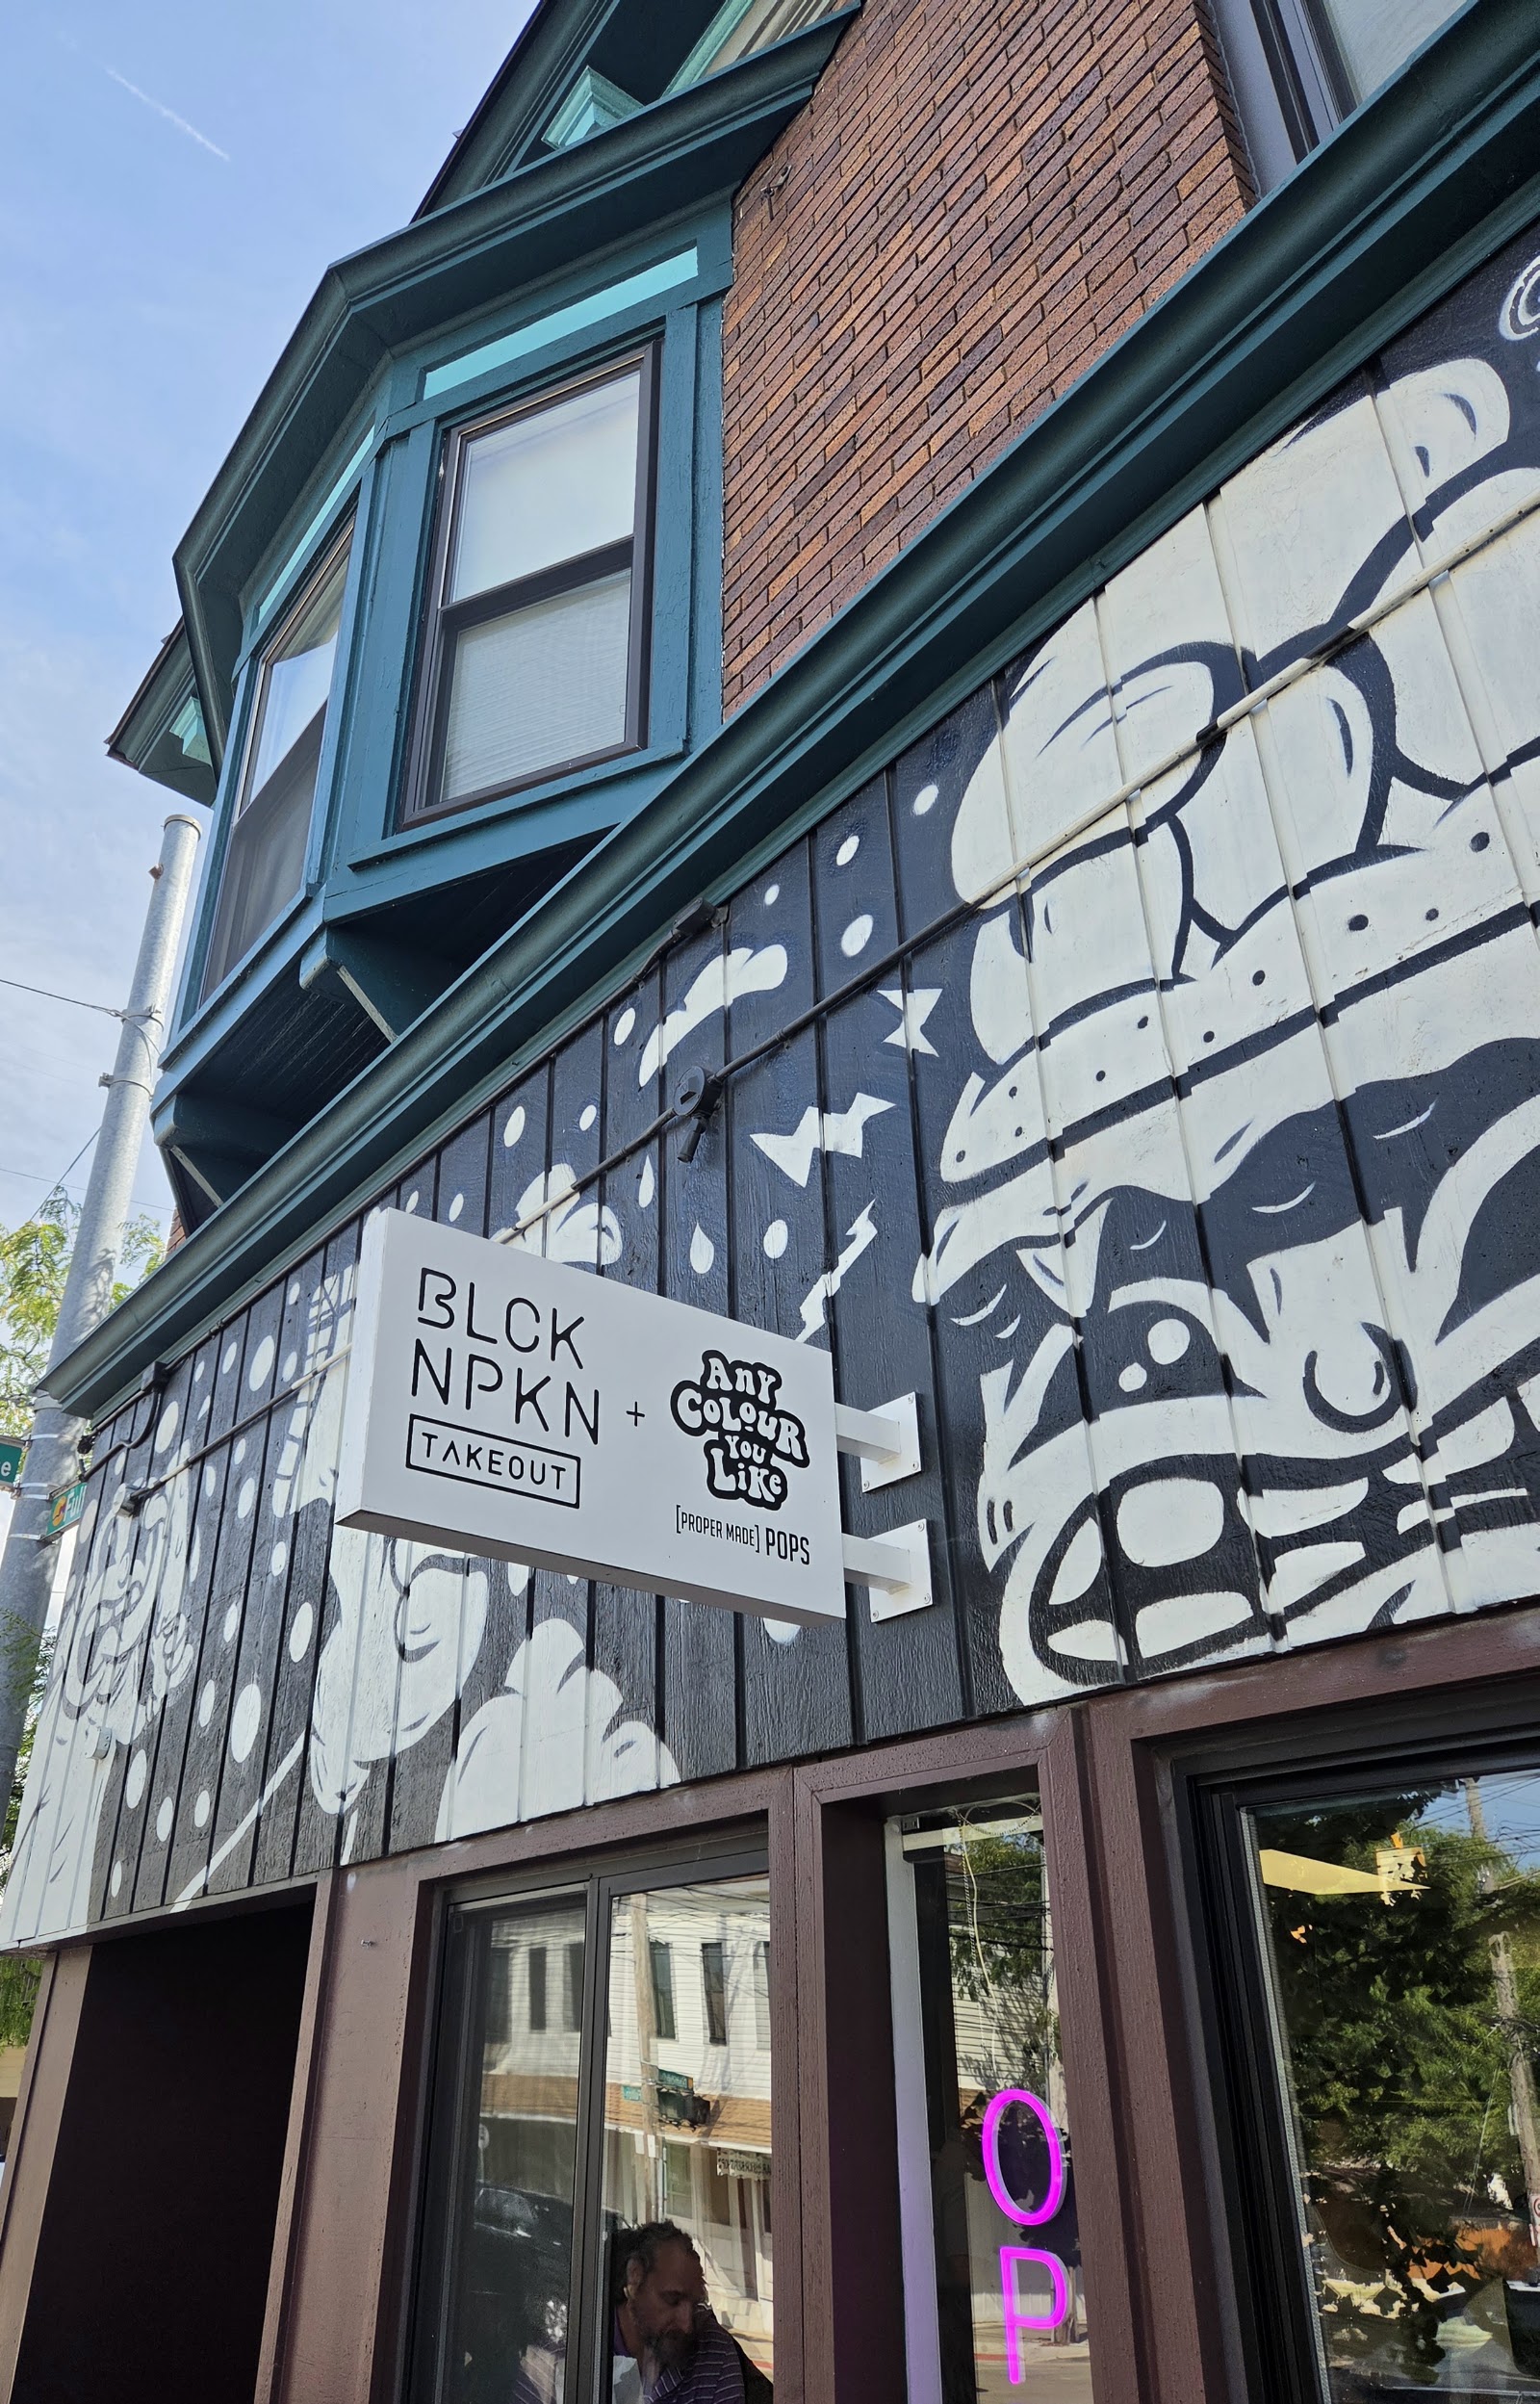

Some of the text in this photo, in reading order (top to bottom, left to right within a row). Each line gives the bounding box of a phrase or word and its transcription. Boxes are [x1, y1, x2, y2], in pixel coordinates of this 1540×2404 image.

[417, 1267, 585, 1370] BLCK
[411, 1338, 600, 1445] NPKN
[421, 1432, 567, 1490] TAKEOUT
[676, 1504, 810, 1565] [PROPER MADE] POPS
